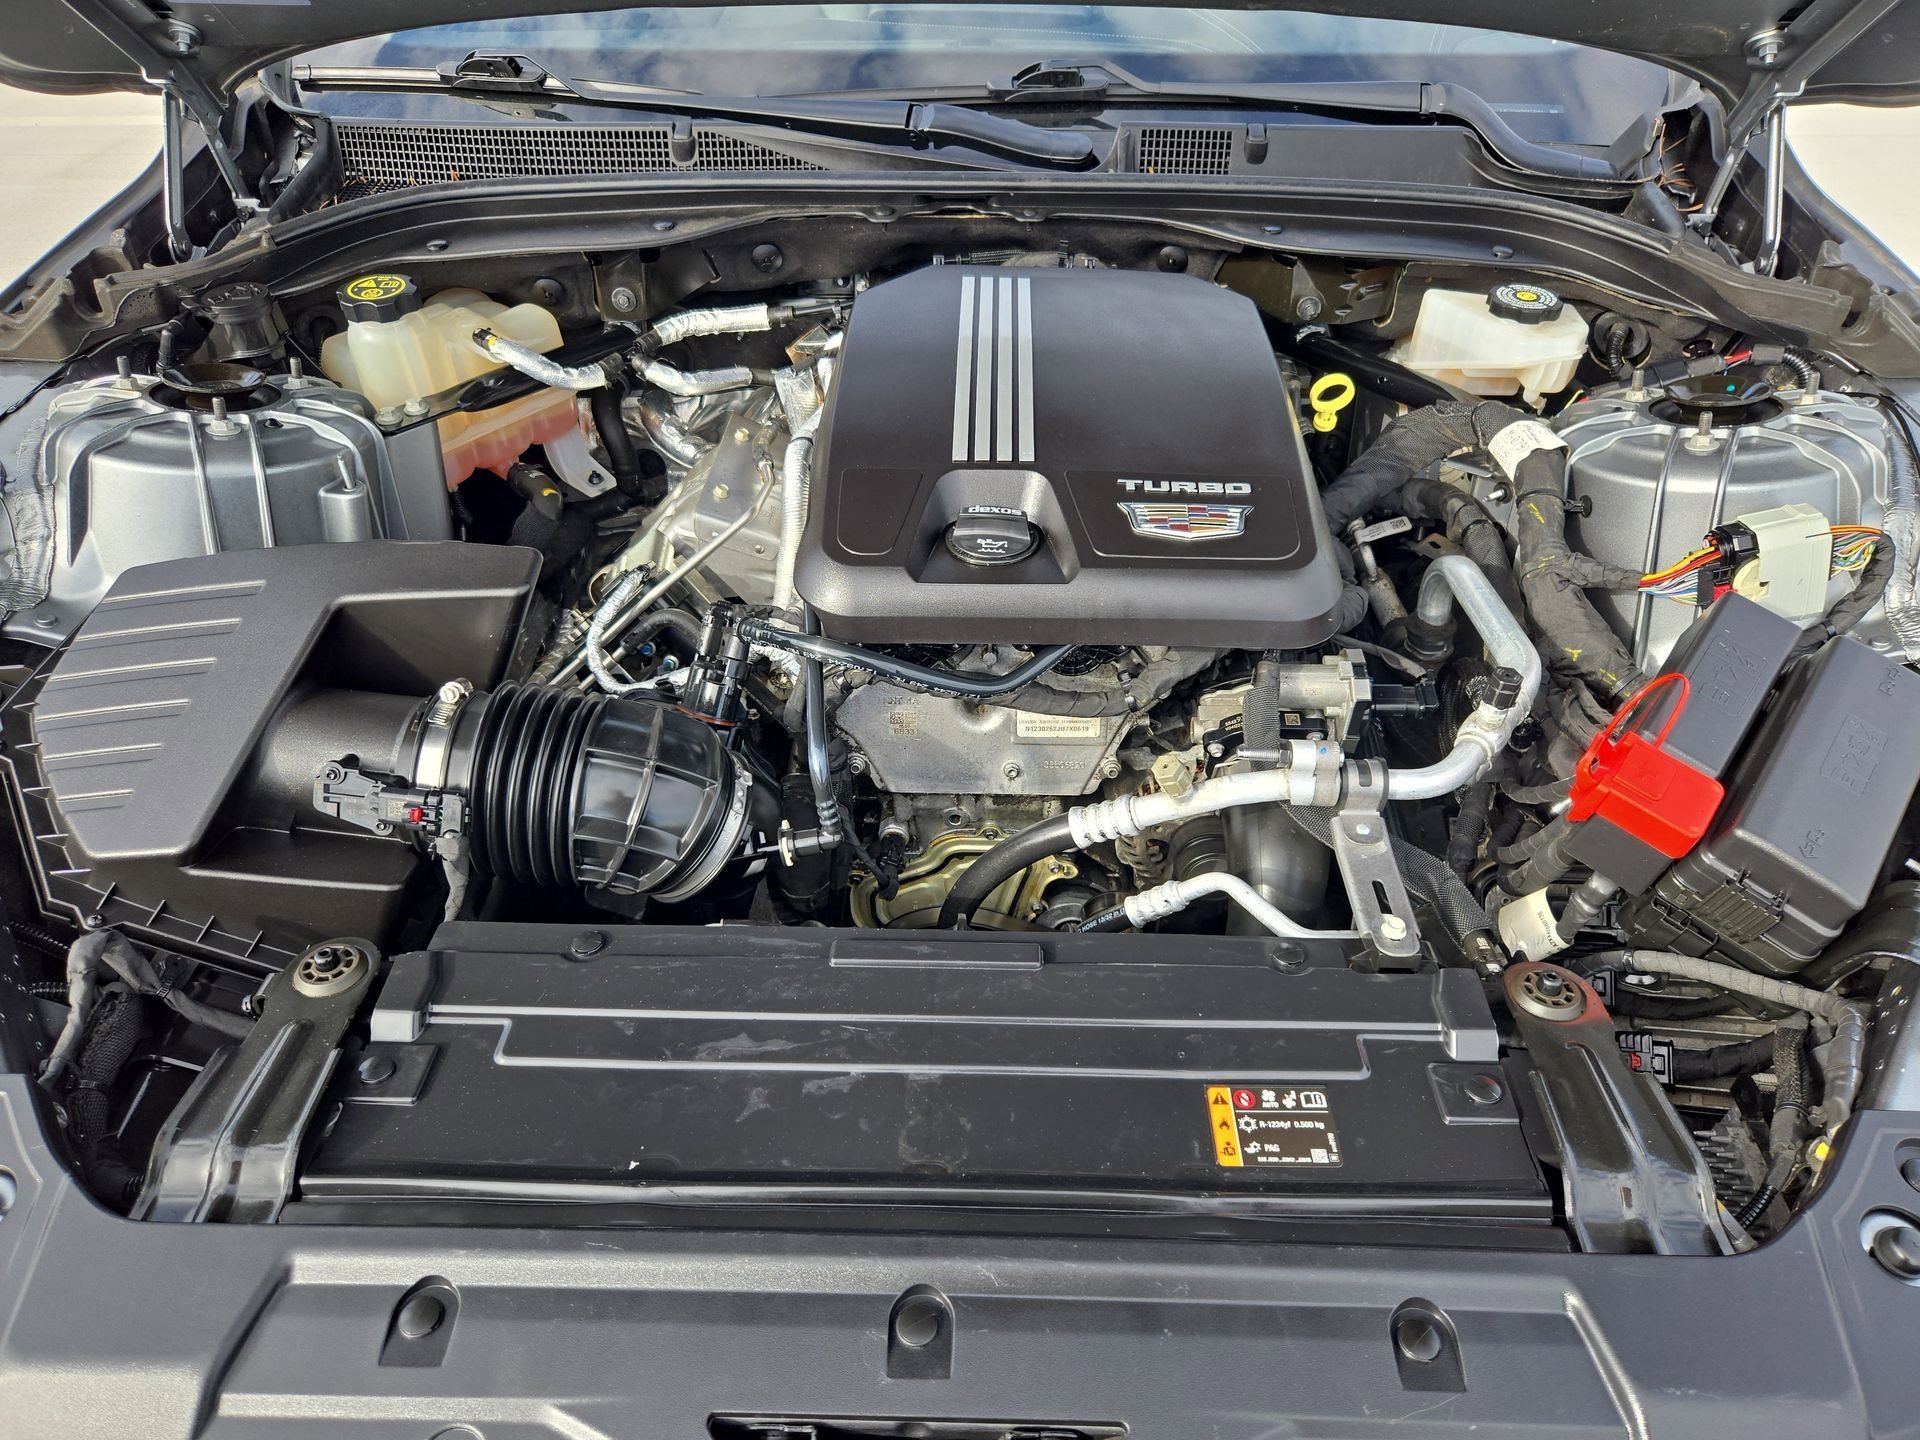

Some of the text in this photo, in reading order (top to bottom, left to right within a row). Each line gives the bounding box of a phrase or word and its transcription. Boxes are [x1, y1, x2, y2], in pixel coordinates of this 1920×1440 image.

[1117, 478, 1251, 494] TURBO
[968, 505, 1022, 516] dexos
[1259, 1120, 1325, 1130] R-1234yf 0.500 kg
[1264, 1143, 1280, 1152] PAG
